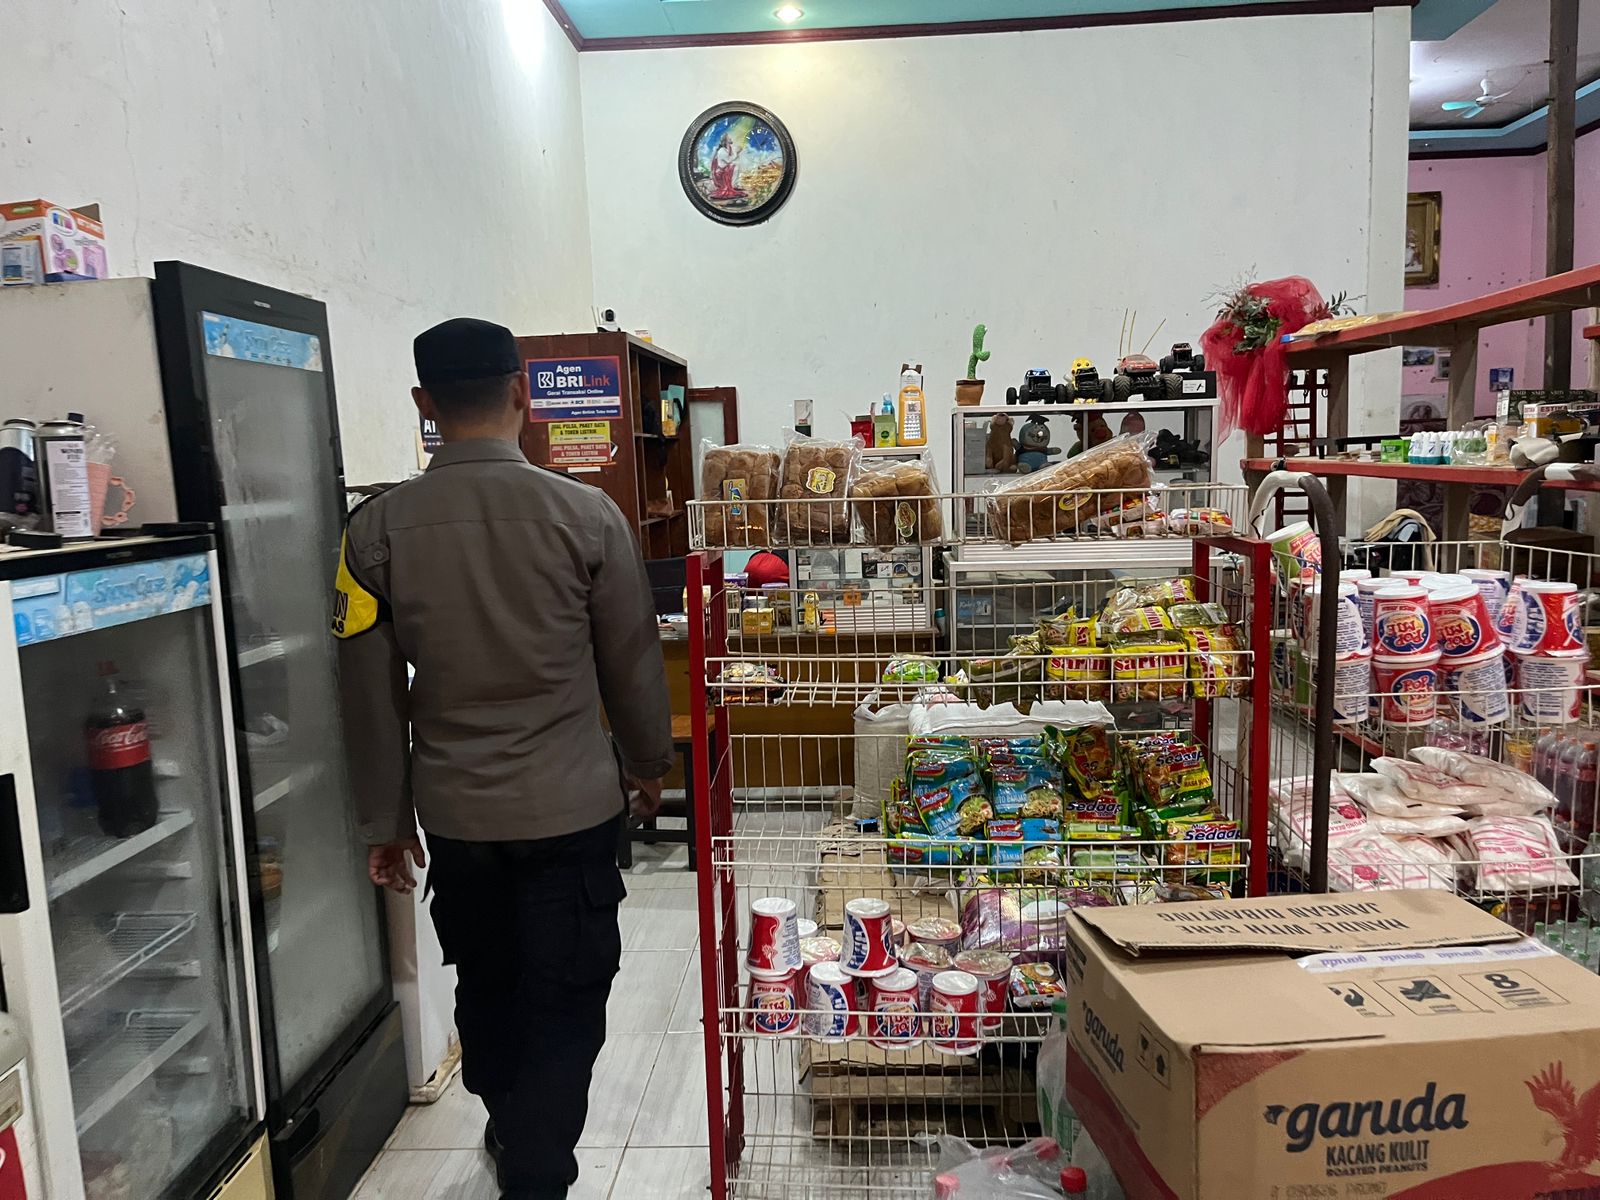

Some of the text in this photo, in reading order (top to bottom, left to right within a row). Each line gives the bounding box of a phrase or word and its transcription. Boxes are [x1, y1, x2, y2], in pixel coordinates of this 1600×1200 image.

[556, 365, 582, 374] Agen
[556, 375, 611, 388] BRILink
[1394, 629, 1424, 646] POP
[1445, 632, 1472, 650] POP
[1156, 902, 1383, 922] JANGAN DIBANTING
[1175, 918, 1411, 935] HANDLE WITH CARE
[1484, 973, 1521, 989] 8
[1085, 1007, 1124, 1073] garuda
[1286, 1082, 1469, 1153] garuda
[1326, 1140, 1430, 1166] KACANG KULIT
[1326, 1162, 1429, 1177] ROASTED PEANUTS
